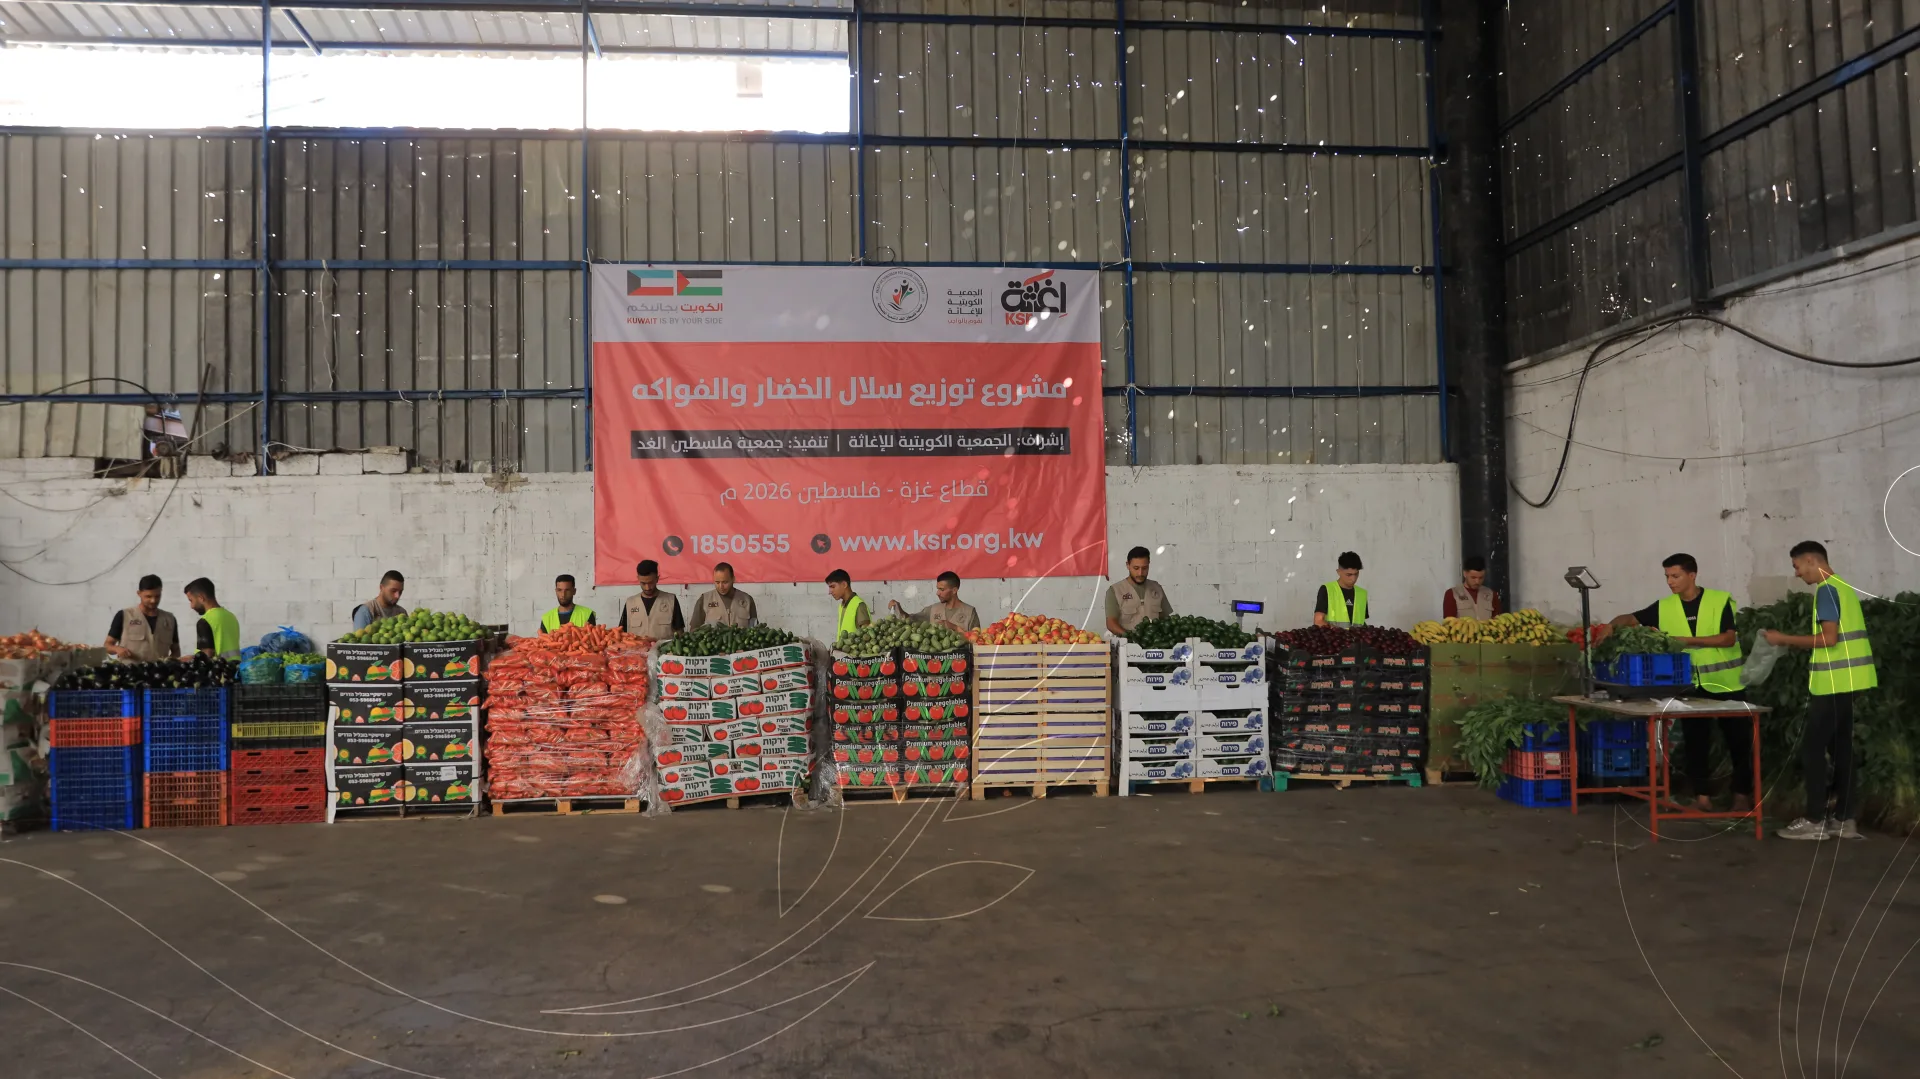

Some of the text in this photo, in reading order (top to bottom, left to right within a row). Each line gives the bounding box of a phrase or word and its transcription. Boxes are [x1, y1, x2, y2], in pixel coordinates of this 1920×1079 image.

[947, 289, 982, 297] الجمعية
[627, 303, 723, 313] الكويت بجانبكم
[948, 299, 982, 307] الكويتية
[948, 308, 982, 316] للإغاثة
[632, 374, 1067, 407] مشروع توزيع سلال الخضار والفواكه
[637, 437, 666, 450] الغد
[671, 436, 733, 453] فلسطين
[738, 437, 783, 452] جمعية
[788, 436, 829, 452] تنفيذ:
[849, 434, 894, 452] للإغاثة
[899, 435, 953, 451] الكويتية
[957, 434, 1011, 450] الجمعية
[1017, 434, 1064, 451] إشراف:
[720, 486, 737, 505] م
[744, 483, 791, 499] 2026
[797, 482, 881, 504] فلسطين
[900, 481, 933, 503] غزة
[940, 480, 988, 503] قطاع
[690, 534, 790, 554] 1850555
[839, 528, 1044, 554] www.ksr.org.kw
[759, 648, 781, 658] ירקות
[934, 652, 965, 661] vegetables
[685, 658, 708, 666] ירקות
[760, 658, 783, 668] העונה
[836, 678, 896, 688] Premium vegetables
[765, 694, 787, 703] ירקות
[935, 698, 967, 708] vegetables
[689, 702, 709, 710] ירקות
[766, 704, 788, 713] העונה
[864, 703, 897, 711] vegetables
[688, 712, 710, 720] העונה
[763, 737, 785, 746] ירקות
[683, 744, 705, 753] ירקות
[763, 746, 786, 755] העונה
[761, 771, 783, 780] ירקות
[685, 781, 707, 790] ירקות
[762, 780, 784, 789] העונה
[686, 791, 709, 799] העונה
